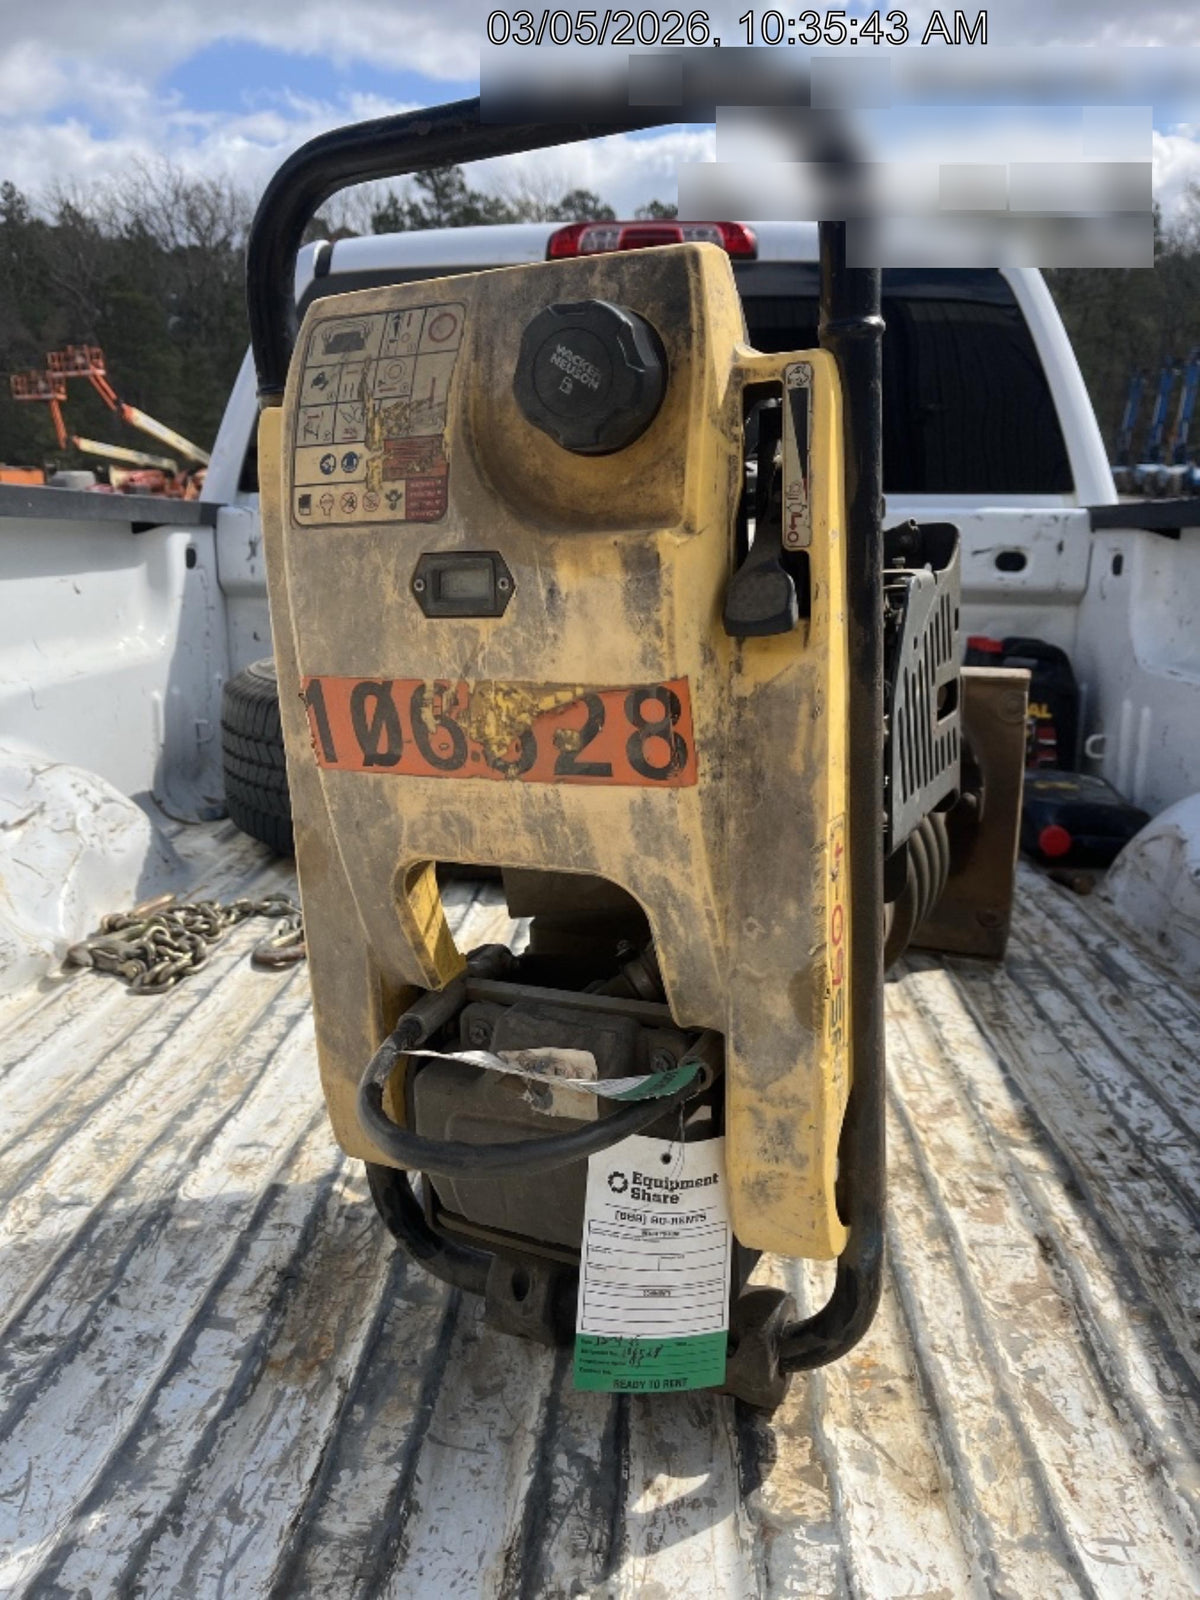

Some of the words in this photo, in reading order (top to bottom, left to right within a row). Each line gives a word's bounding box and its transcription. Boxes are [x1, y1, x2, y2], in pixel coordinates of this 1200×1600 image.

[550, 353, 600, 392] NEUSON
[556, 344, 602, 381] WACKER
[631, 1171, 719, 1191] Equipment
[630, 1187, 681, 1205] Share
